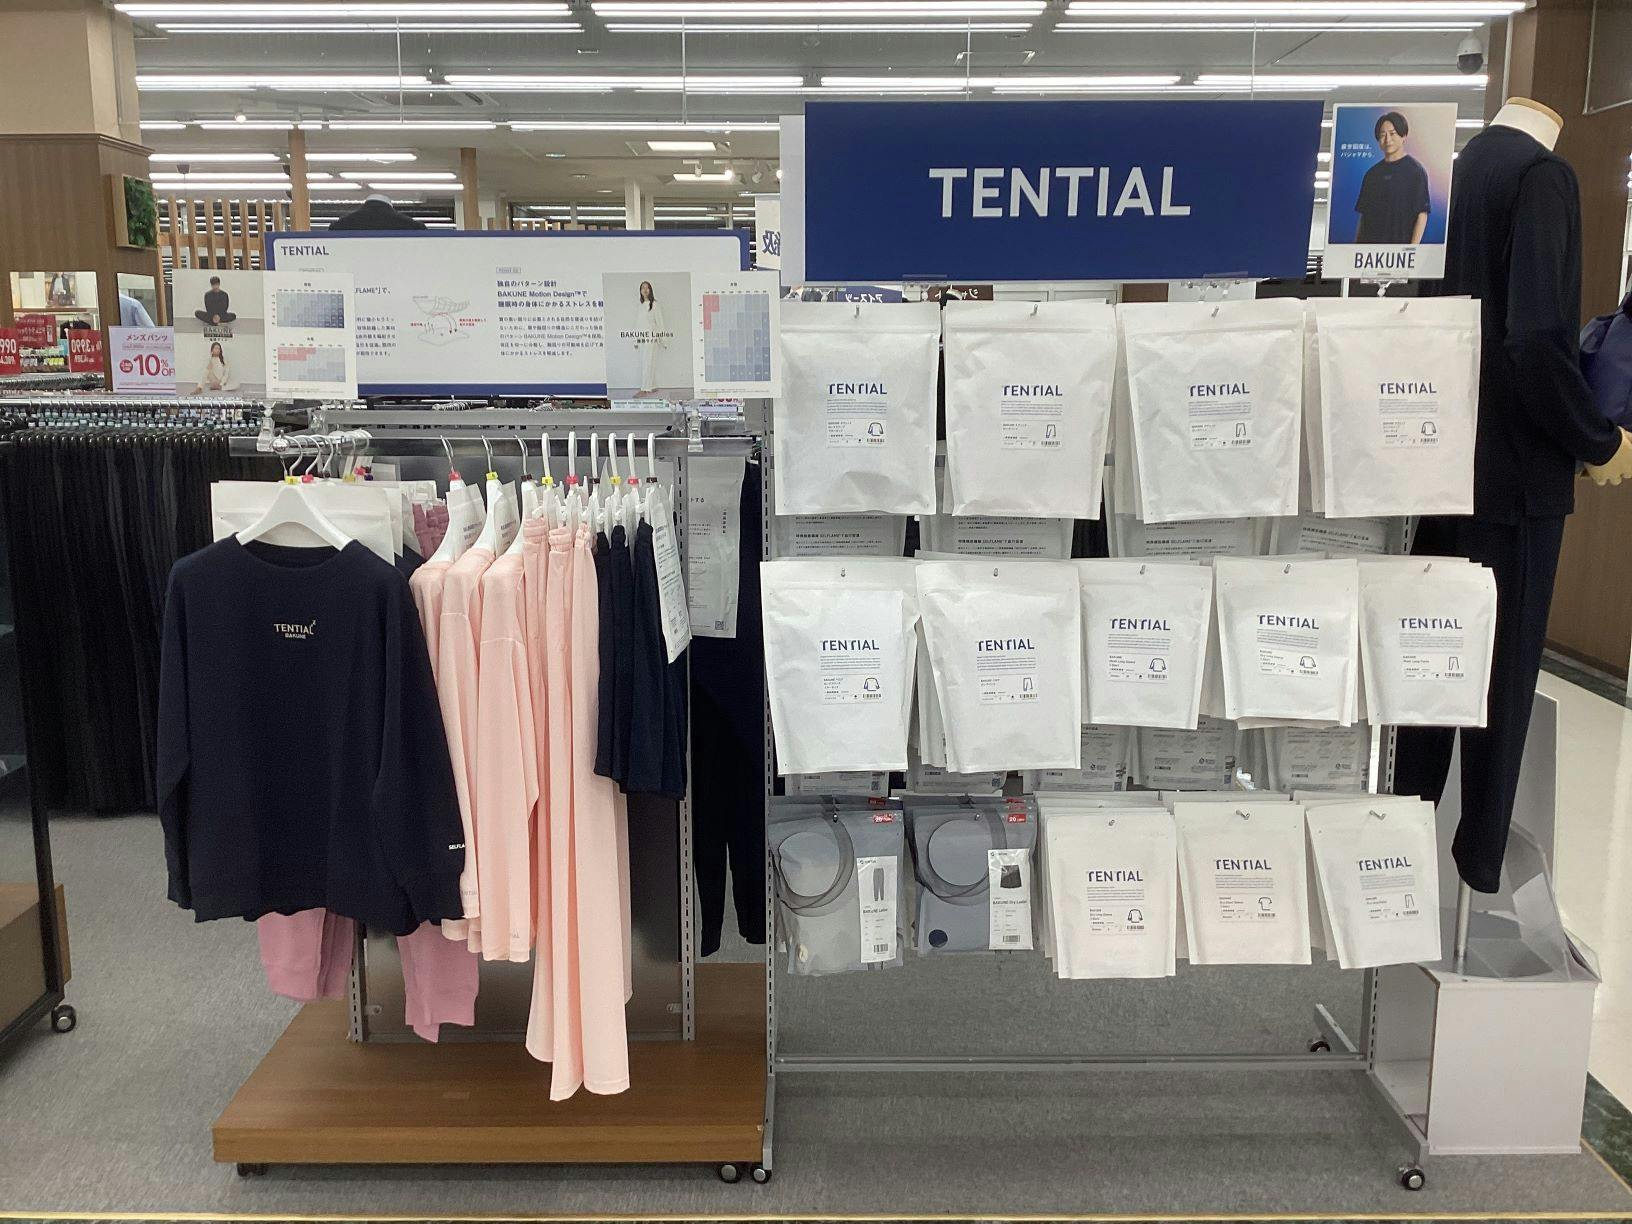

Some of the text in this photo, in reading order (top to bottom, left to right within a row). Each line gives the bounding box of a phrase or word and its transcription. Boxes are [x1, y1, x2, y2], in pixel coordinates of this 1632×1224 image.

[928, 166, 1191, 218] TENTIAL
[281, 245, 329, 256] TENTIAL
[1354, 252, 1416, 269] BAKUNE
[828, 383, 888, 395] TENTIAL
[1001, 384, 1063, 397] TENTIAL
[1188, 382, 1250, 397] TENTIAL
[1379, 382, 1437, 394] TENTIAL
[1109, 618, 1170, 631] TENTIAL
[1257, 614, 1319, 629] TENTIAL
[1399, 618, 1463, 629] TENTIAL
[273, 622, 315, 635] TENTIAL
[820, 639, 880, 651] TENTIAL
[976, 638, 1035, 651] TENTIAL
[1215, 859, 1272, 870] TENTIAL
[1356, 856, 1412, 871] TENTIAL
[1087, 870, 1143, 882] TENTIAL
